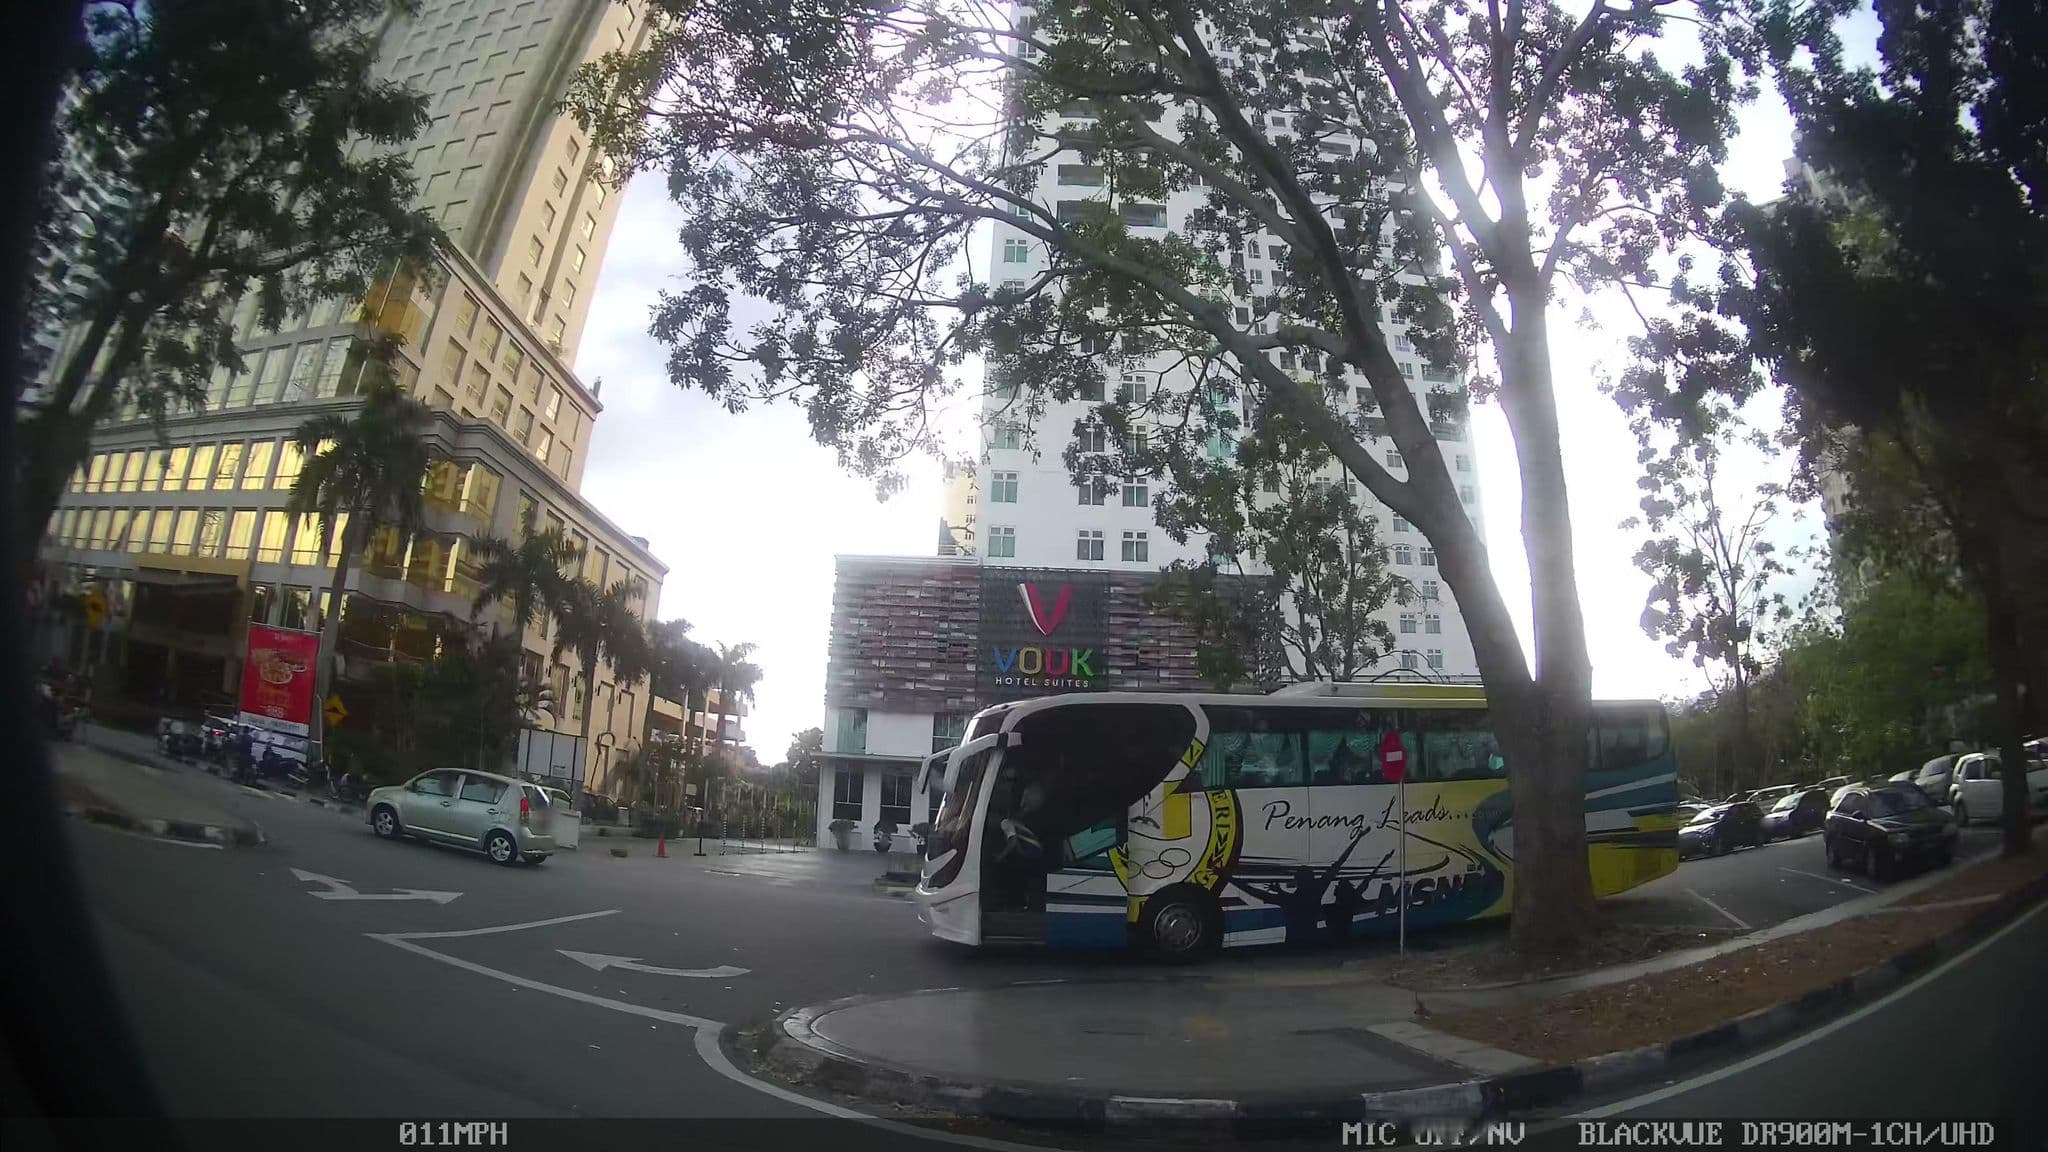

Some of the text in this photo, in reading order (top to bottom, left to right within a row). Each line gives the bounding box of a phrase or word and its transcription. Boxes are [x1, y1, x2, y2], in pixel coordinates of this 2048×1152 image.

[994, 646, 1095, 677] VOUK
[995, 677, 1090, 688] HOTEL SUITES
[1262, 800, 1366, 840] Penang
